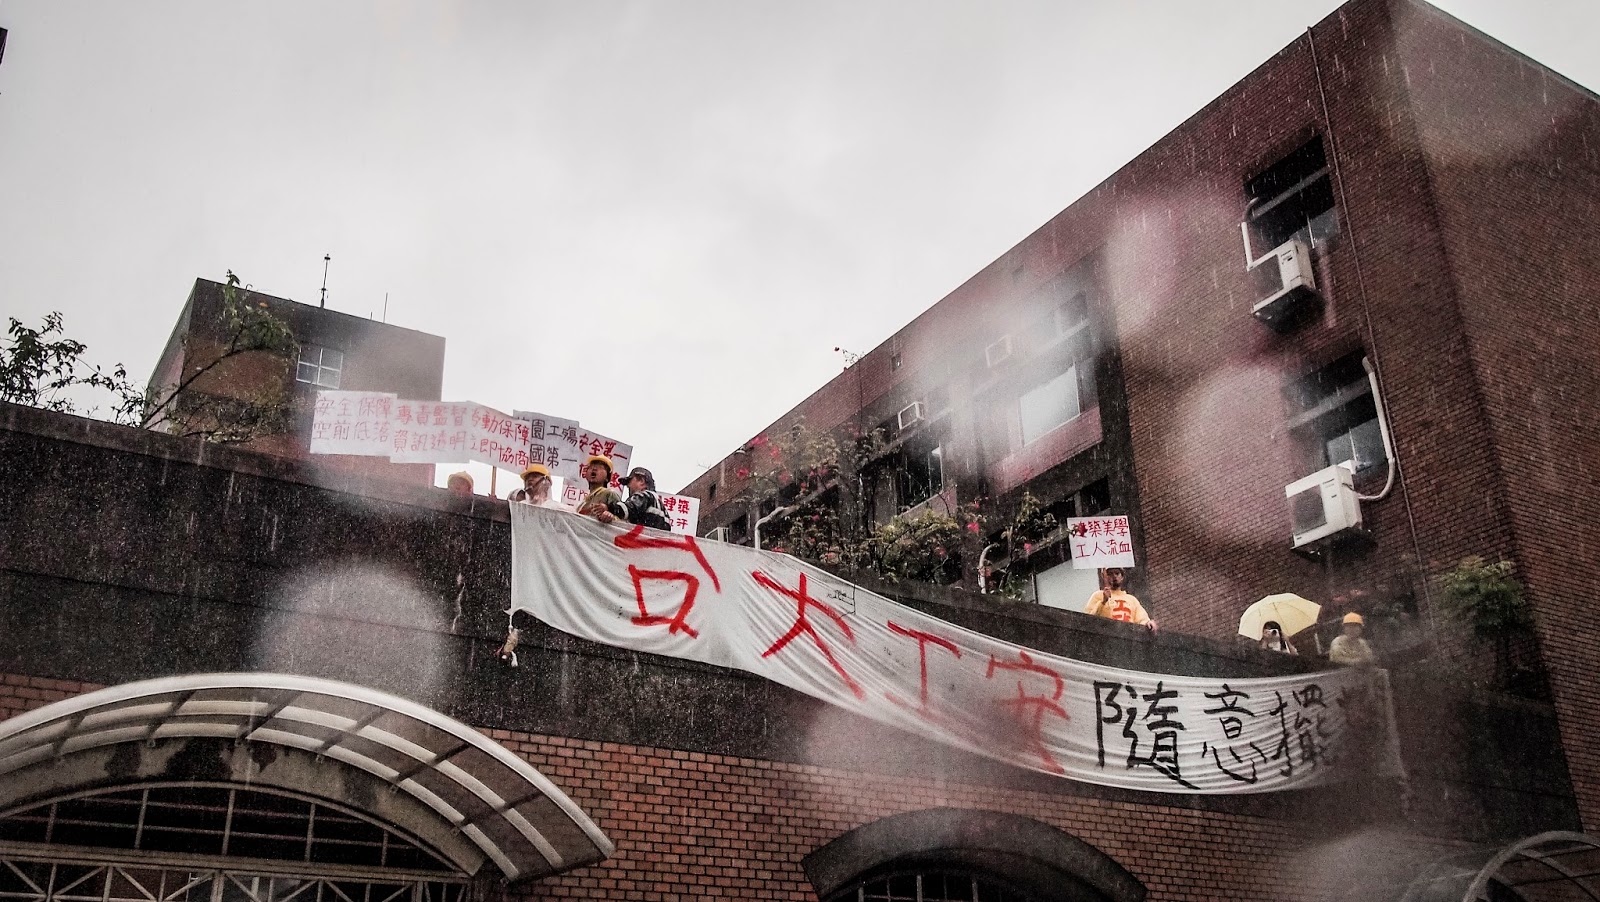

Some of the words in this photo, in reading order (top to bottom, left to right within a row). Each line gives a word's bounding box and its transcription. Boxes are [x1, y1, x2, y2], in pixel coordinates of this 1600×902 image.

[316, 396, 392, 418] 安全保障
[394, 429, 466, 452] 資訊透明
[579, 433, 627, 460] 安全第一
[1075, 539, 1131, 558] 工人流血
